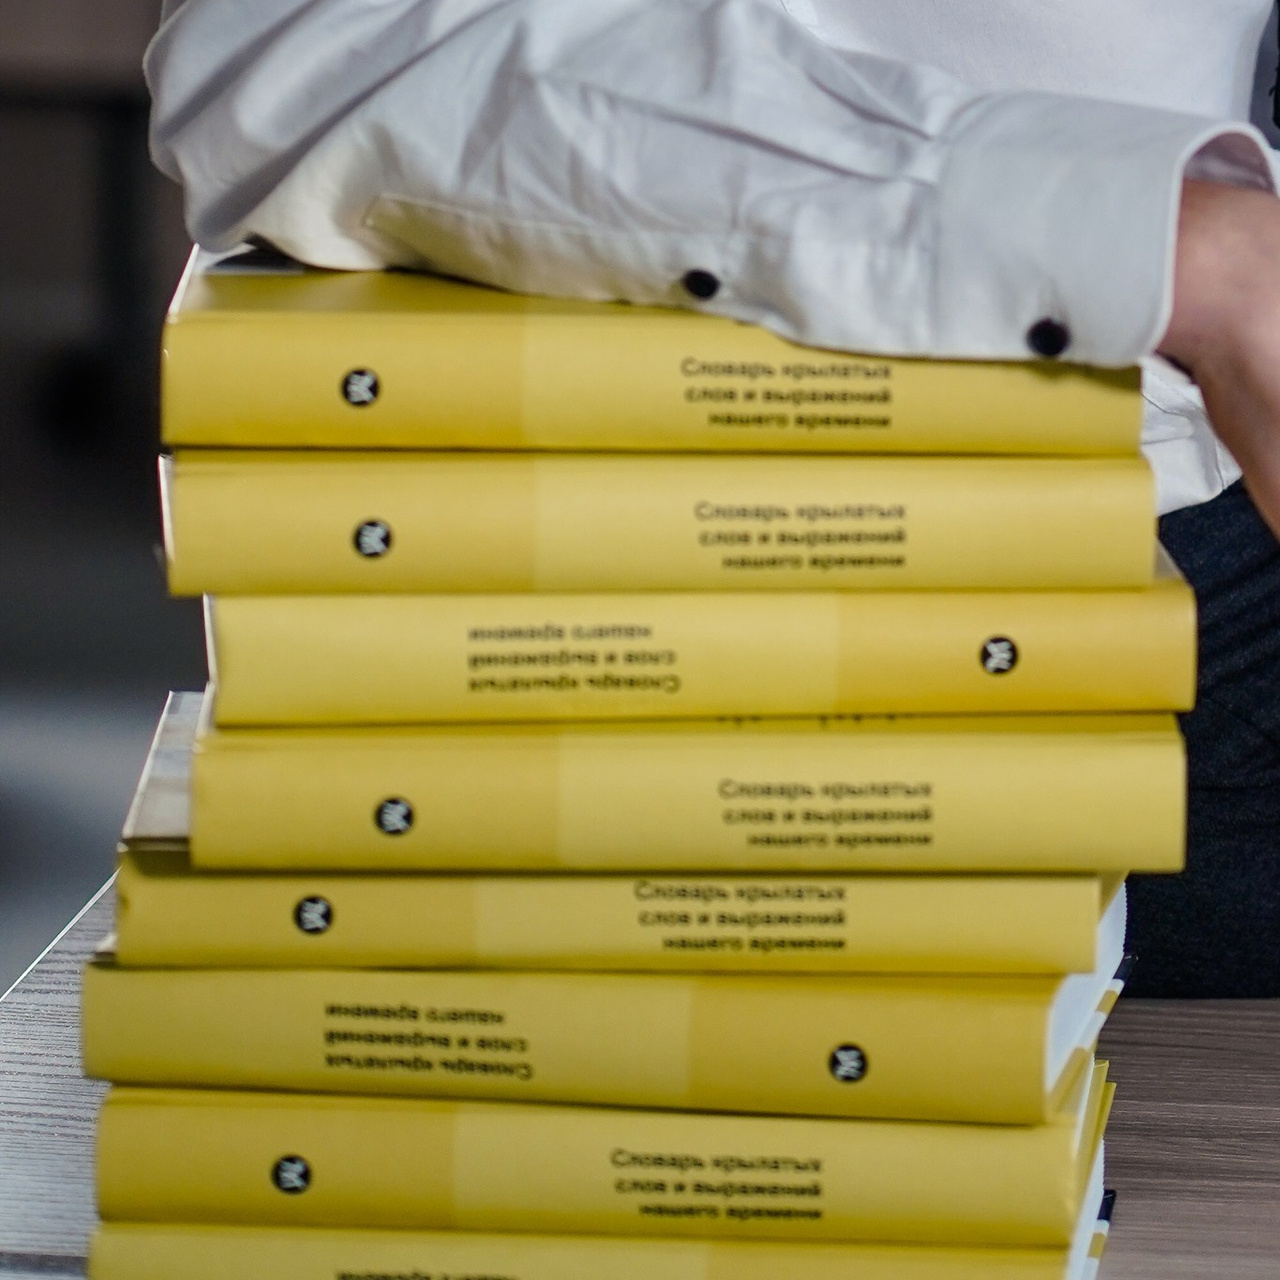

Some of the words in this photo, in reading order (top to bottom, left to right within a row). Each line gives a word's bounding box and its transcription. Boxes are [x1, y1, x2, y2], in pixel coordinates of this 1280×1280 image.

[681, 356, 776, 380] Словарь
[781, 362, 891, 380] крылатых
[684, 388, 738, 403] слов
[743, 390, 757, 402] и
[762, 386, 892, 405] выражений
[708, 412, 790, 428] нашего
[794, 413, 891, 431] времени
[695, 500, 790, 523] Словарь
[796, 504, 905, 523] крылатых
[699, 530, 751, 547] слов
[757, 532, 771, 544] и
[776, 526, 906, 548] выражений
[722, 555, 804, 569] нашего
[808, 554, 905, 572] времени
[718, 778, 815, 802] Словарь
[821, 782, 932, 801] крылатых
[722, 808, 776, 824] слов
[782, 810, 795, 822] и
[802, 805, 932, 827] выражений
[746, 833, 828, 848] нашего
[833, 833, 932, 850] времени
[634, 880, 730, 904] Словарь
[736, 886, 846, 904] крылатых
[638, 911, 692, 927] слов
[697, 913, 710, 924] и
[716, 909, 845, 930] выражений
[661, 937, 744, 951] нашего
[749, 937, 846, 954] времени
[611, 1149, 704, 1172] Словарь
[711, 1155, 822, 1173] крылатых
[615, 1178, 667, 1194] слов
[674, 1182, 687, 1193] и
[693, 1180, 822, 1197] выражений
[638, 1204, 719, 1218] нашего
[725, 1206, 822, 1221] времени
